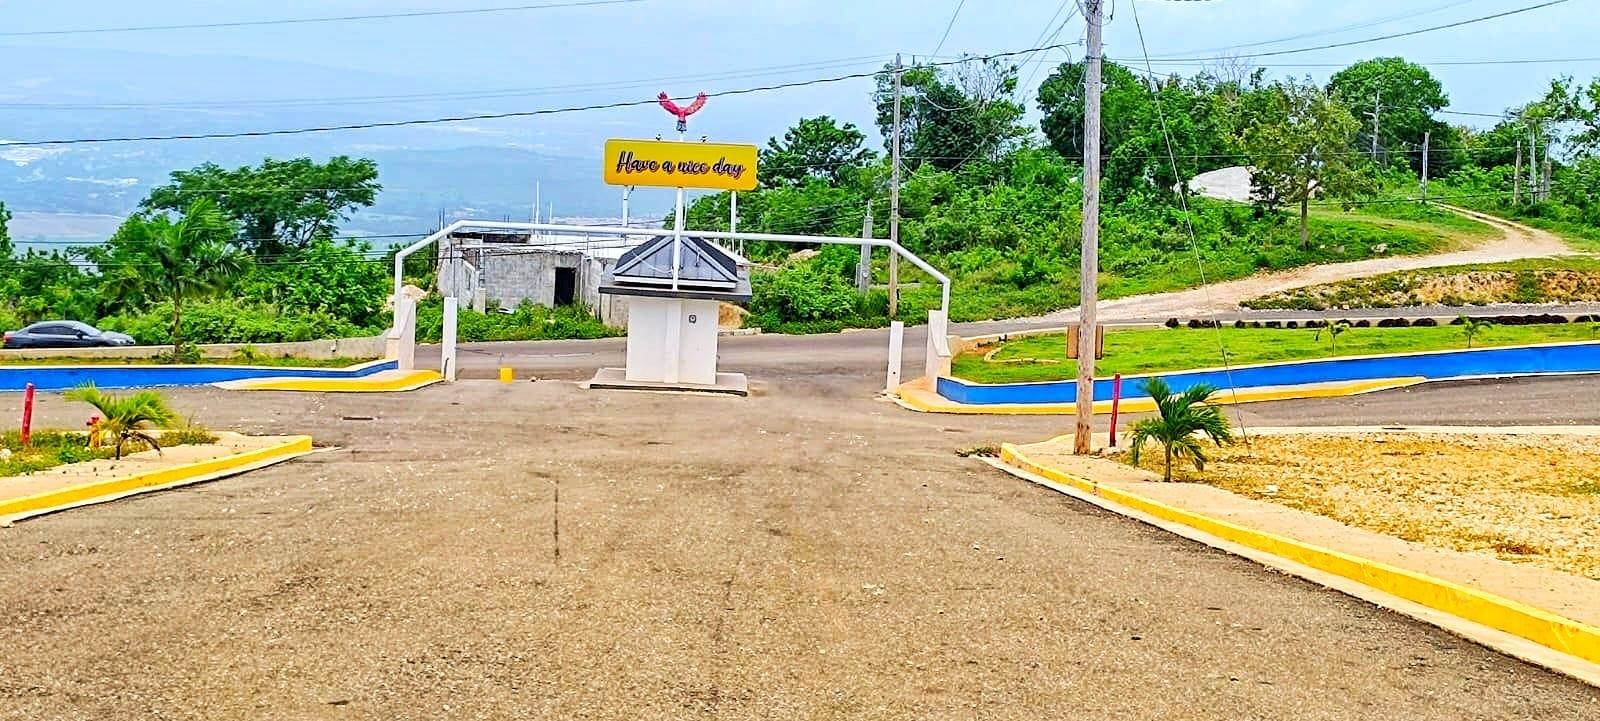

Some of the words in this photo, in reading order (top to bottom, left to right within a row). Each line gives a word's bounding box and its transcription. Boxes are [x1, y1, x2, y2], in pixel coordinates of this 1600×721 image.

[616, 151, 659, 174] Have
[662, 160, 676, 175] a
[678, 161, 711, 175] nice
[713, 156, 746, 179] day
